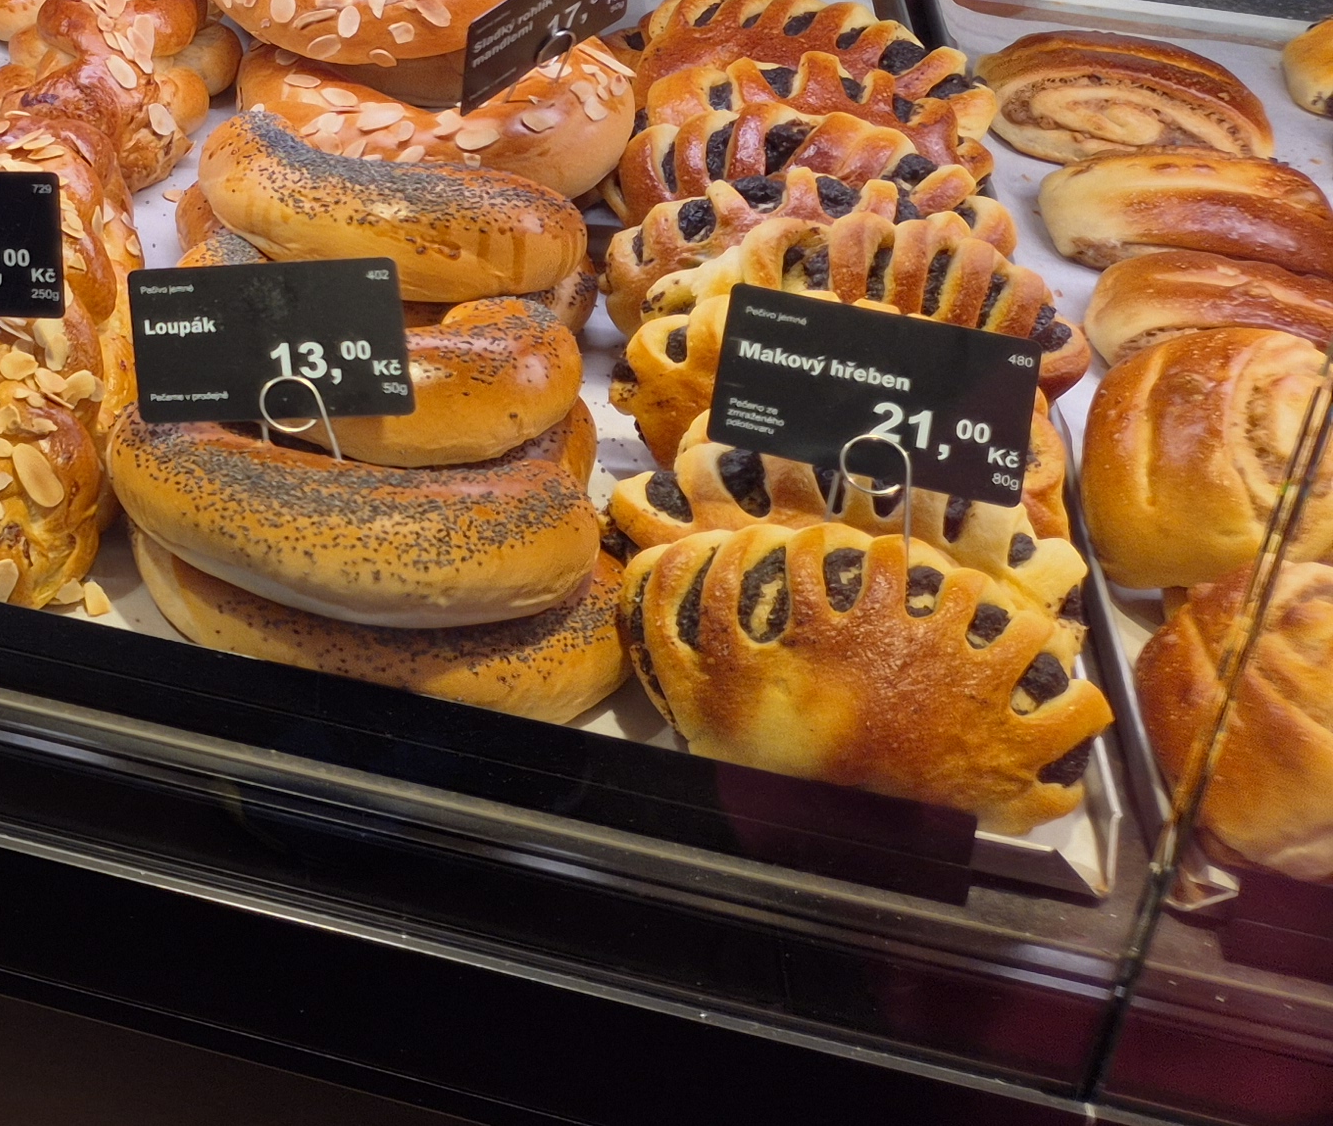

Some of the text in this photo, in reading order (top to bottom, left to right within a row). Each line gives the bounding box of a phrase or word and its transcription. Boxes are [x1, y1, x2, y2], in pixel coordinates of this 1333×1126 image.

[473, 17, 515, 53] Sladký
[517, 0, 554, 24] rohlík
[472, 21, 534, 68] mandlemi
[31, 268, 56, 283] Kč
[31, 289, 60, 301] 250g
[746, 306, 807, 326] Pečivo jemné
[144, 316, 217, 337] Loupák
[270, 340, 402, 384] 13,00 Kč
[739, 340, 911, 392] Makový hřeben
[1007, 353, 1033, 367] 480
[382, 383, 408, 396] 50g
[869, 401, 1021, 468] 21,00 Kč
[992, 472, 1020, 491] 80g
